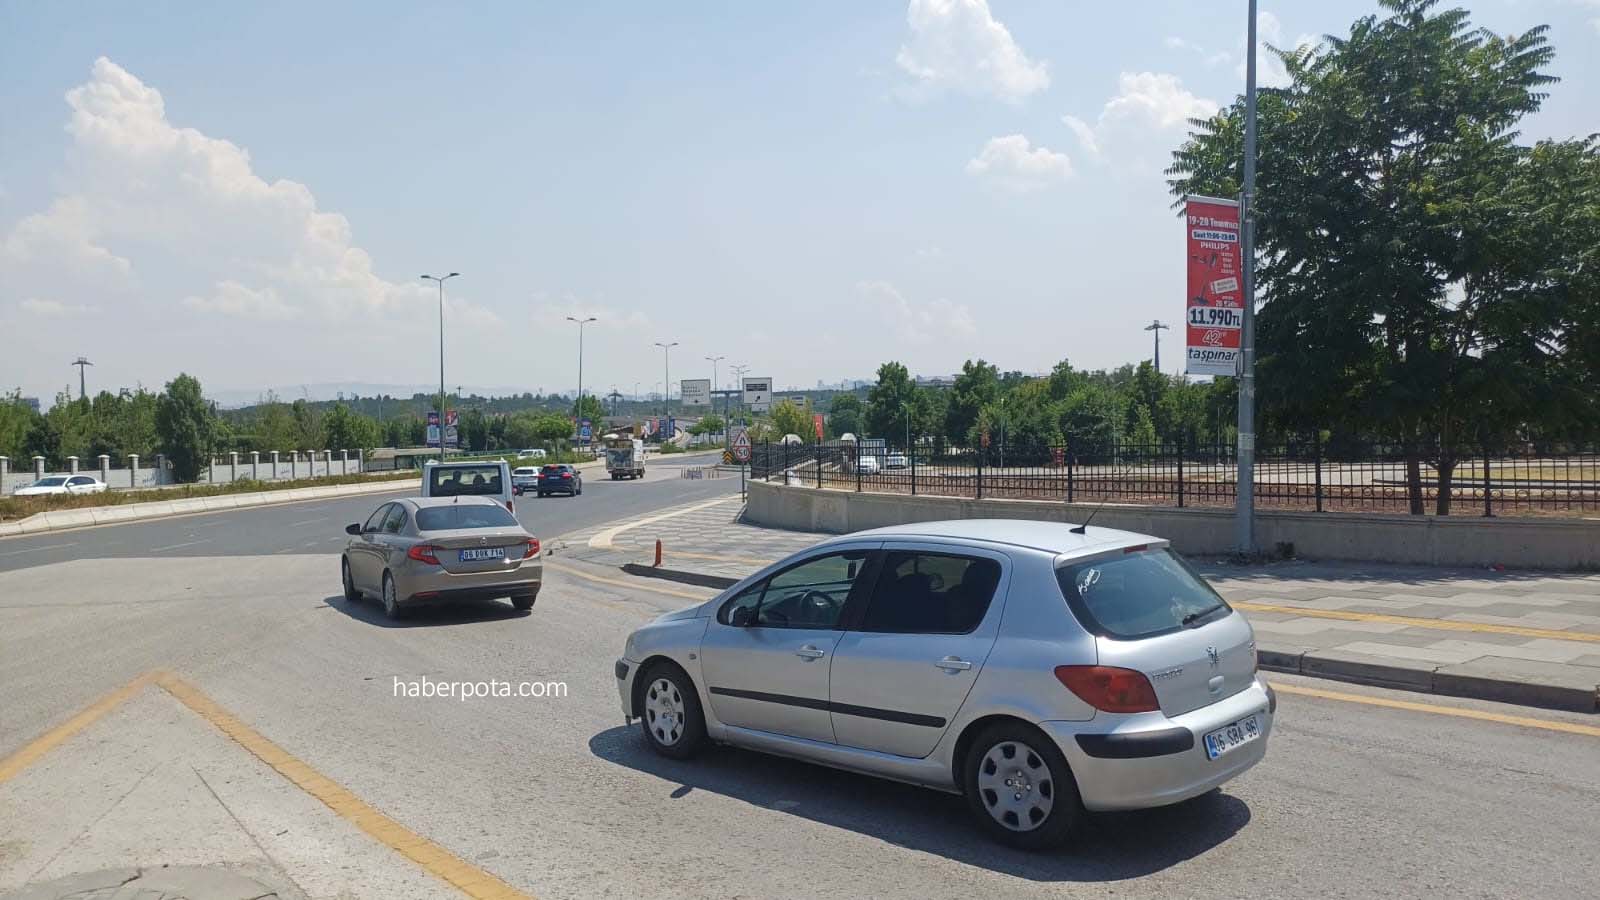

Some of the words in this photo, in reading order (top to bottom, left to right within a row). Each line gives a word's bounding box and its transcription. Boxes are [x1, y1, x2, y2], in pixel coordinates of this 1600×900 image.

[1200, 241, 1230, 250] PHILIPS
[1188, 347, 1238, 362] taşpınar
[738, 449, 748, 457] 50
[1212, 734, 1226, 752] 06
[1226, 726, 1245, 746] SBA
